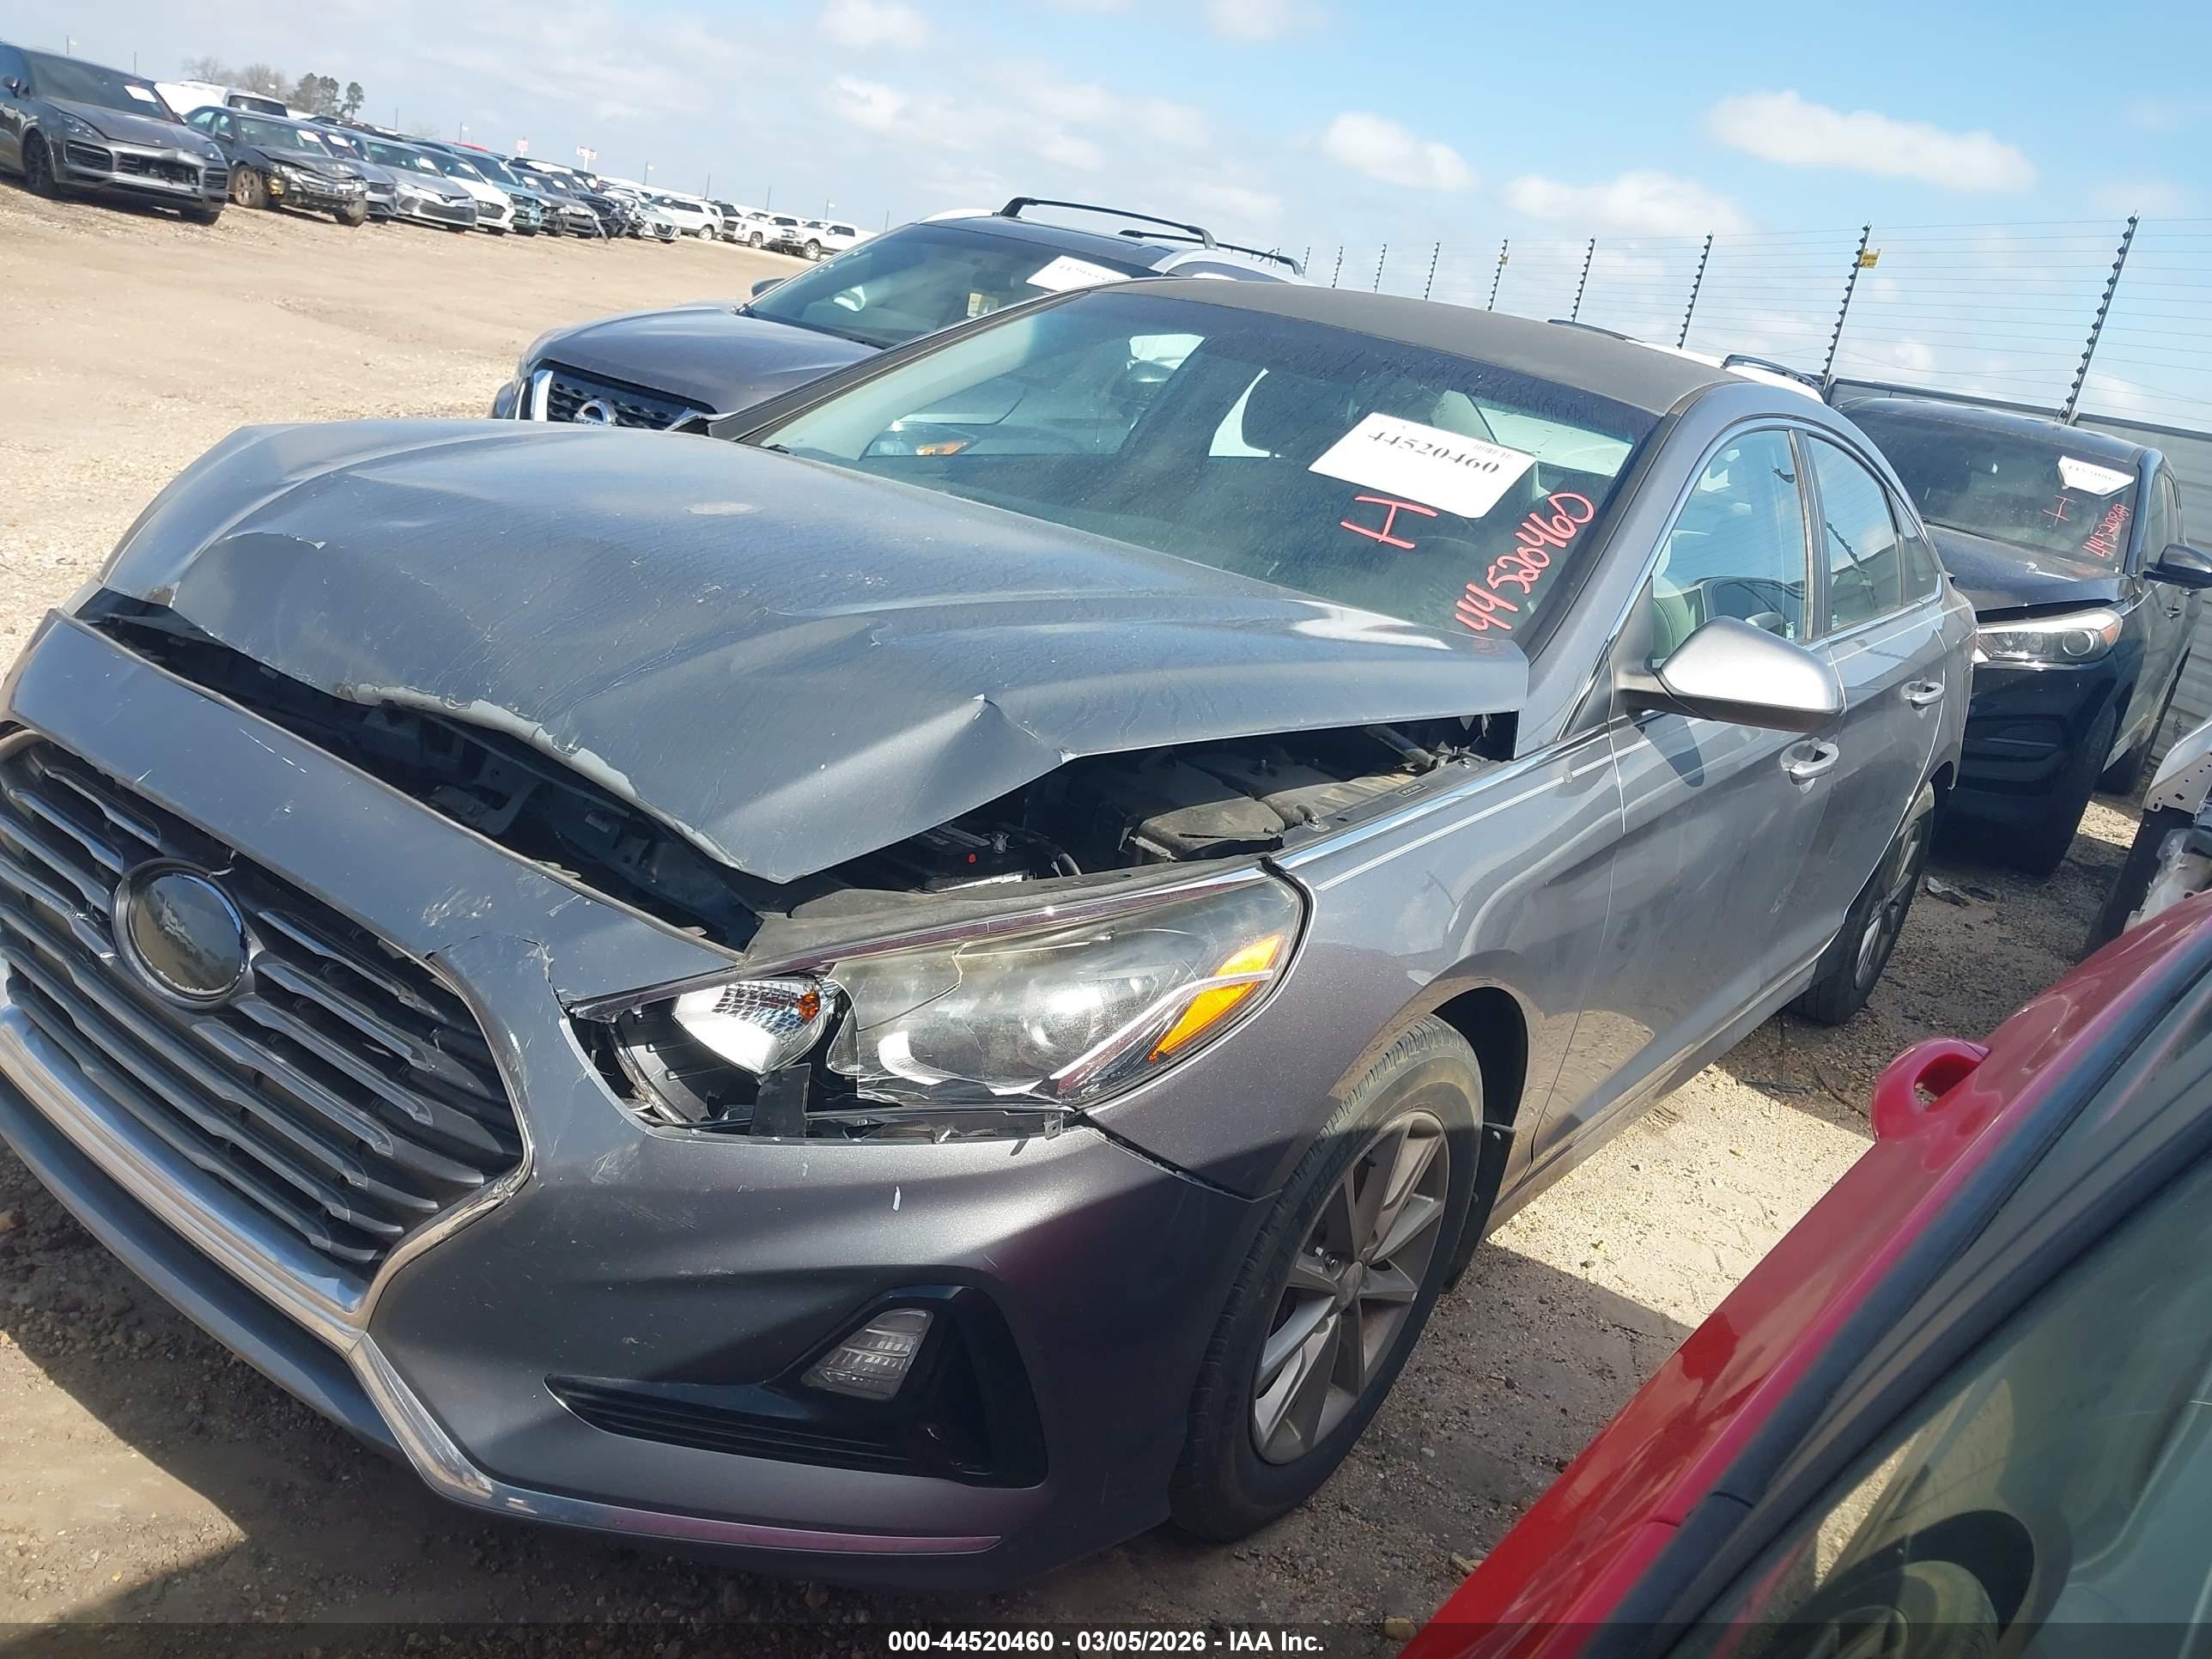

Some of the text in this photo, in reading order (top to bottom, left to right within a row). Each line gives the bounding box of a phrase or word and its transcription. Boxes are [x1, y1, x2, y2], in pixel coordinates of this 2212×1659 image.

[1368, 431, 1500, 474] 44520460
[1340, 495, 1438, 550] H
[1455, 492, 1595, 630] 44520460
